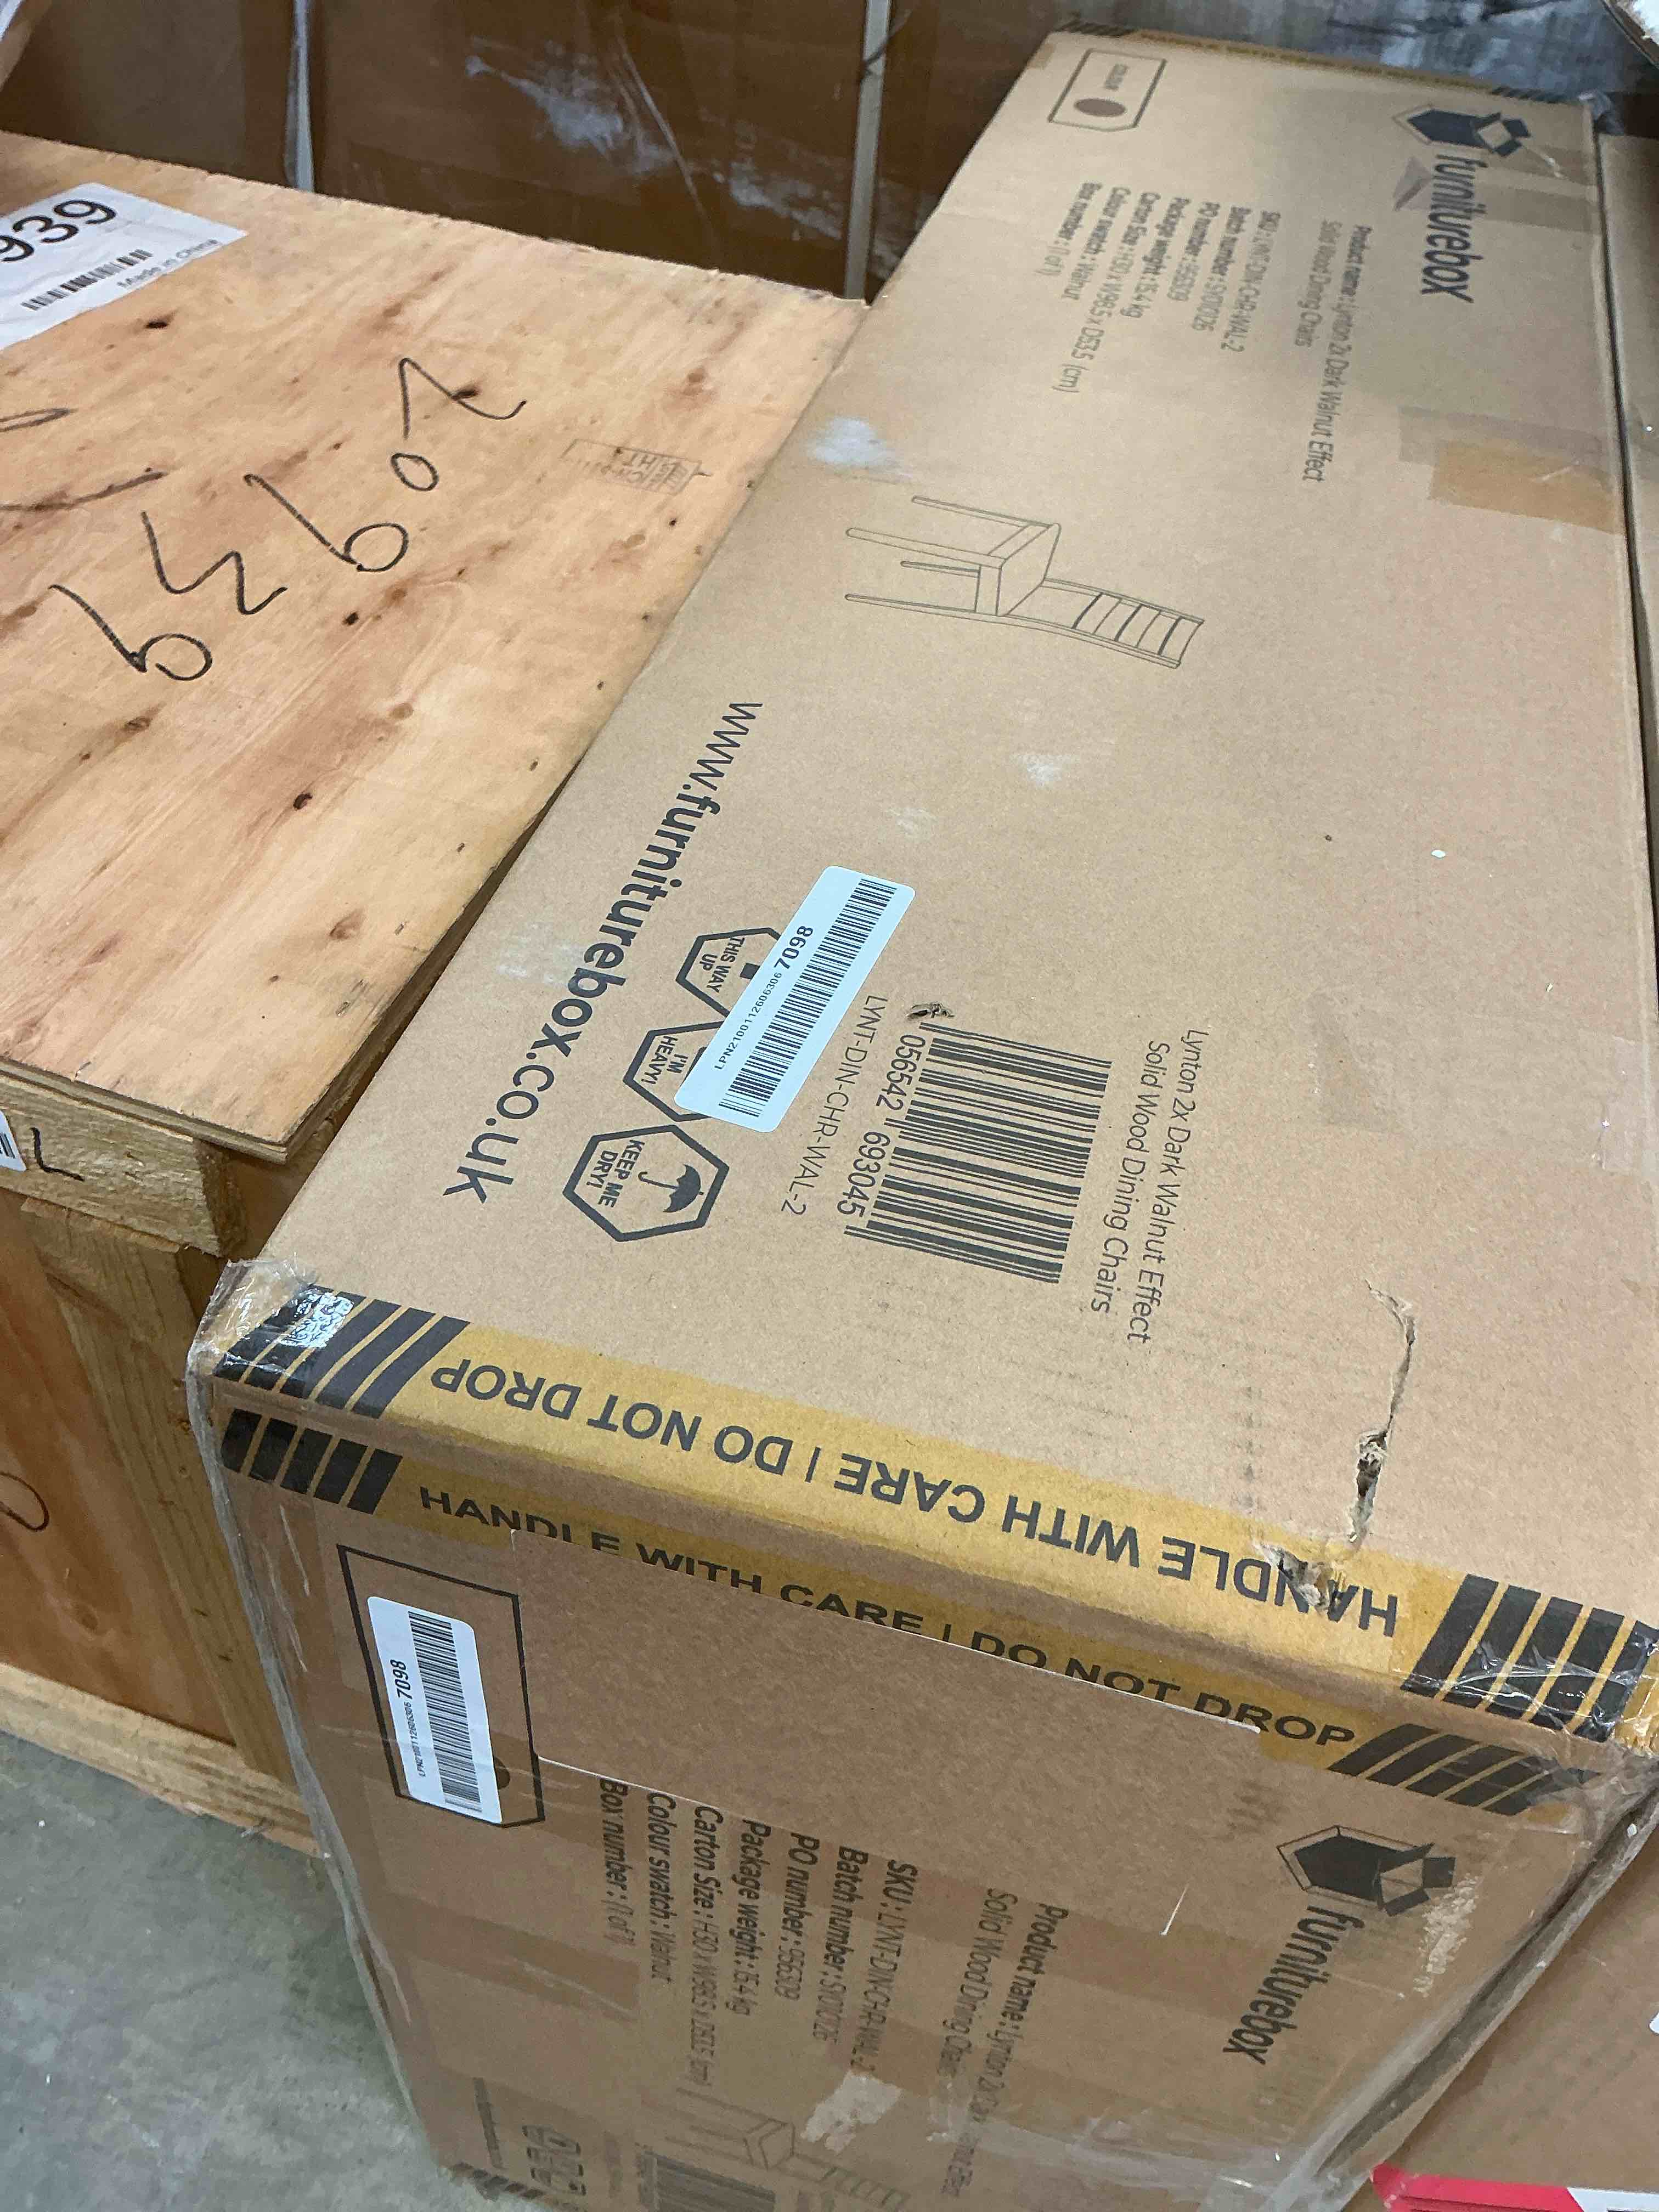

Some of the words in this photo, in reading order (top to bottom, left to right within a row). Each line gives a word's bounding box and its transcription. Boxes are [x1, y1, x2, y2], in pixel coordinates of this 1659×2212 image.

[1077, 183, 1102, 199] Box
[1099, 187, 1131, 217] Colour
[1130, 192, 1161, 224] Carton
[1199, 202, 1221, 217] PO
[1056, 202, 1092, 240] number
[1082, 219, 1115, 255] swatch
[1120, 225, 1149, 246] Size
[1153, 196, 1191, 238] Package
[1183, 218, 1216, 257] number
[1224, 207, 1251, 235] Batch
[1257, 211, 1280, 230] SKU
[1318, 220, 1341, 244] Solid
[1420, 154, 1488, 303] furniturebox
[1042, 256, 1065, 267] of
[1109, 252, 1136, 273] H30
[1137, 239, 1176, 276] weight
[1210, 236, 1240, 276] number
[1312, 245, 1336, 273] Wood
[1347, 226, 1370, 264] Product
[1060, 263, 1094, 301] Walnut
[1089, 283, 1123, 317] W98.5
[1299, 274, 1329, 310] Dining
[1340, 266, 1359, 296] name
[1119, 303, 1150, 319] kg
[1294, 312, 1322, 348] Chairs
[1327, 303, 1357, 341] Lynton
[1070, 327, 1105, 360] D53.5
[1328, 343, 1349, 356] 2x
[1050, 363, 1090, 394] (cm)
[1322, 359, 1348, 387] Dark
[1311, 390, 1342, 438] Walnut
[1302, 441, 1333, 483] Effect
[443, 702, 763, 1203] www.furniturebox.co.uk
[699, 953, 718, 971] UP
[720, 937, 745, 963] THIS
[774, 926, 814, 970] 7098
[707, 966, 731, 992] WAY
[641, 1036, 678, 1084] HEAVY!
[667, 1054, 689, 1074] I'M
[876, 1034, 926, 1112] 056542
[1141, 1040, 1170, 1088] Solid
[1176, 1030, 1209, 1093] Lynton
[781, 995, 888, 1216] LYNT-DIN-CHR-WAL-2
[1126, 1094, 1160, 1153] Wood
[1171, 1097, 1196, 1122] 2x
[586, 1150, 618, 1188] DRY!
[614, 1139, 645, 1180] KEEP
[1160, 1126, 1190, 1177] Dark
[598, 1182, 624, 1207] ME
[837, 1131, 891, 1217] 693045
[1103, 1157, 1147, 1231] Dining
[1143, 1184, 1181, 1263] Walnut
[1091, 1238, 1129, 1313] Chairs
[1127, 1269, 1164, 1344] Effect
[430, 1359, 583, 1420] DROP
[586, 1394, 702, 1452] NOT
[714, 1425, 793, 1476] DO
[833, 1452, 985, 1523] CARE
[1002, 1494, 1139, 1568] WITH
[636, 1542, 762, 1594] WITH
[780, 1584, 923, 1635] CARE
[971, 1630, 1047, 1669] DO
[1065, 1657, 1181, 1702] NOT
[1194, 1691, 1355, 1746] DROP
[390, 1659, 413, 1700] 7098
[598, 1777, 628, 1819] Box
[645, 1791, 678, 1857] Colour
[690, 1804, 725, 1872] Carton
[601, 1820, 633, 1891] number
[730, 1818, 774, 1902] Package
[787, 1832, 821, 1866] PO
[646, 1856, 679, 1921] swatch
[691, 1872, 723, 1912] Size
[831, 1846, 872, 1906] Batch
[882, 1860, 918, 1904] SKU
[778, 1866, 817, 1939] number
[978, 1888, 1019, 1936] Solid
[608, 1915, 636, 1936] of
[690, 1918, 720, 1955] H30
[726, 1900, 769, 1962] weight
[821, 1904, 861, 1972] number
[1017, 1903, 1068, 1976] Product
[964, 1934, 1005, 1986] Wood
[731, 1968, 759, 1997] 15.4
[1001, 1974, 1037, 2022] name
[1222, 1905, 1365, 2065] furniturebox
[726, 1993, 758, 2019] kg
[943, 1982, 989, 2035] Dining
[977, 2028, 1024, 2081] Lynton
